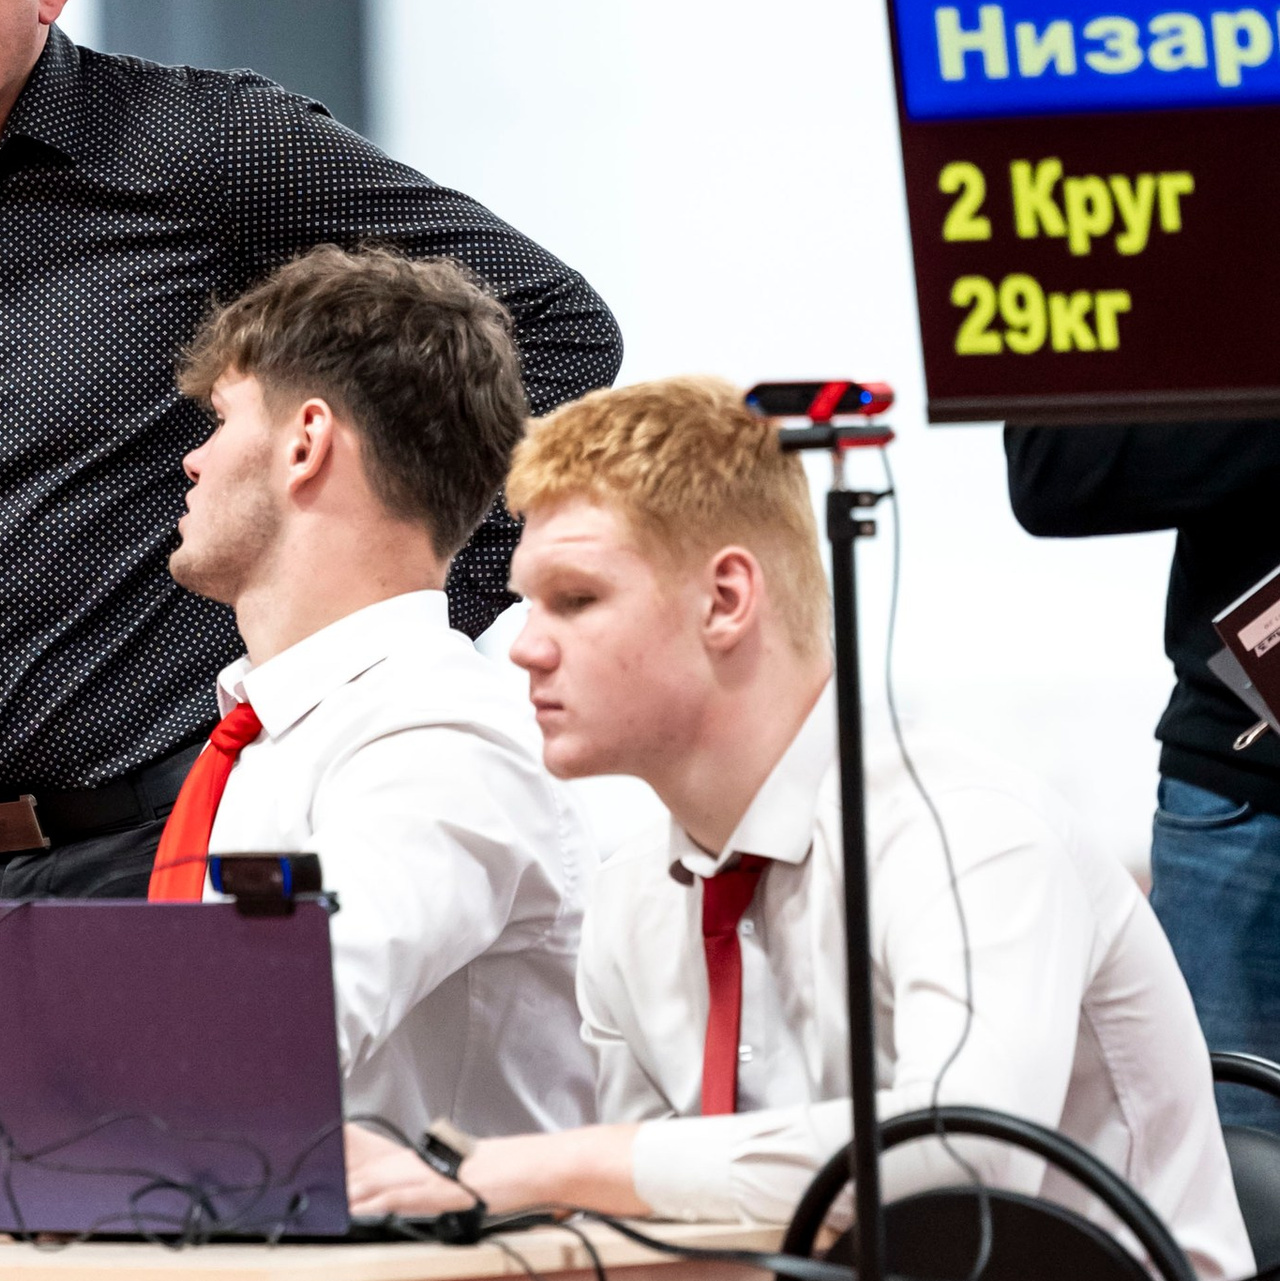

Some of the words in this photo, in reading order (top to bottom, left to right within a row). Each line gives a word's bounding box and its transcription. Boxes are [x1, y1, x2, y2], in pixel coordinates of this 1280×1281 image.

[934, 4, 1280, 88] Низар
[938, 161, 992, 241] 2
[1010, 157, 1195, 256] Круг
[950, 274, 1132, 355] 29кг
